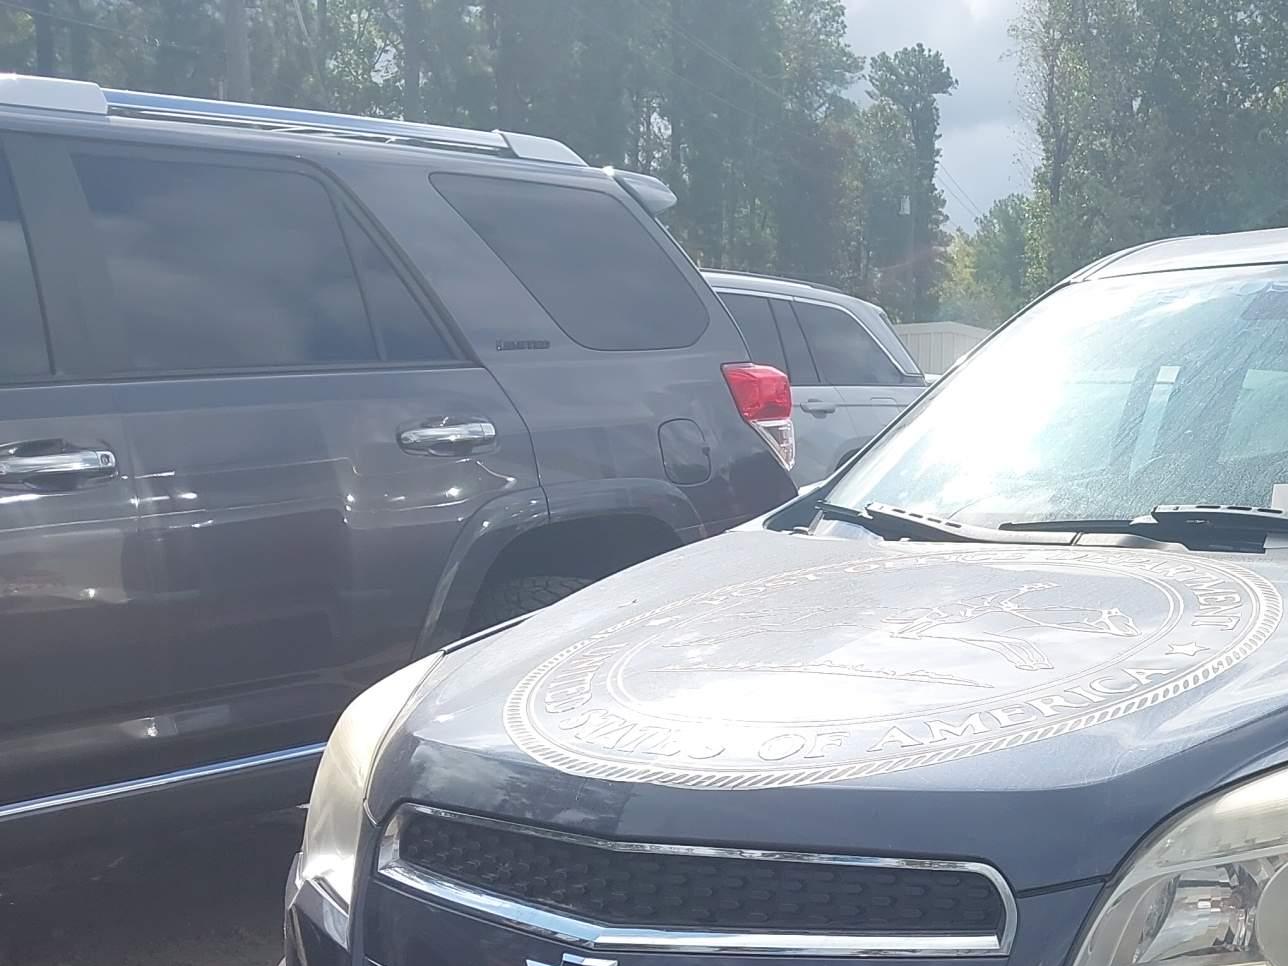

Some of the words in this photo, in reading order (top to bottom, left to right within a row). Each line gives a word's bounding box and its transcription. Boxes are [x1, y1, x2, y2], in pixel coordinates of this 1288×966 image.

[1046, 550, 1243, 632] DEPARTMENT
[757, 731, 851, 762] OF
[866, 667, 1179, 754] AMERICA
